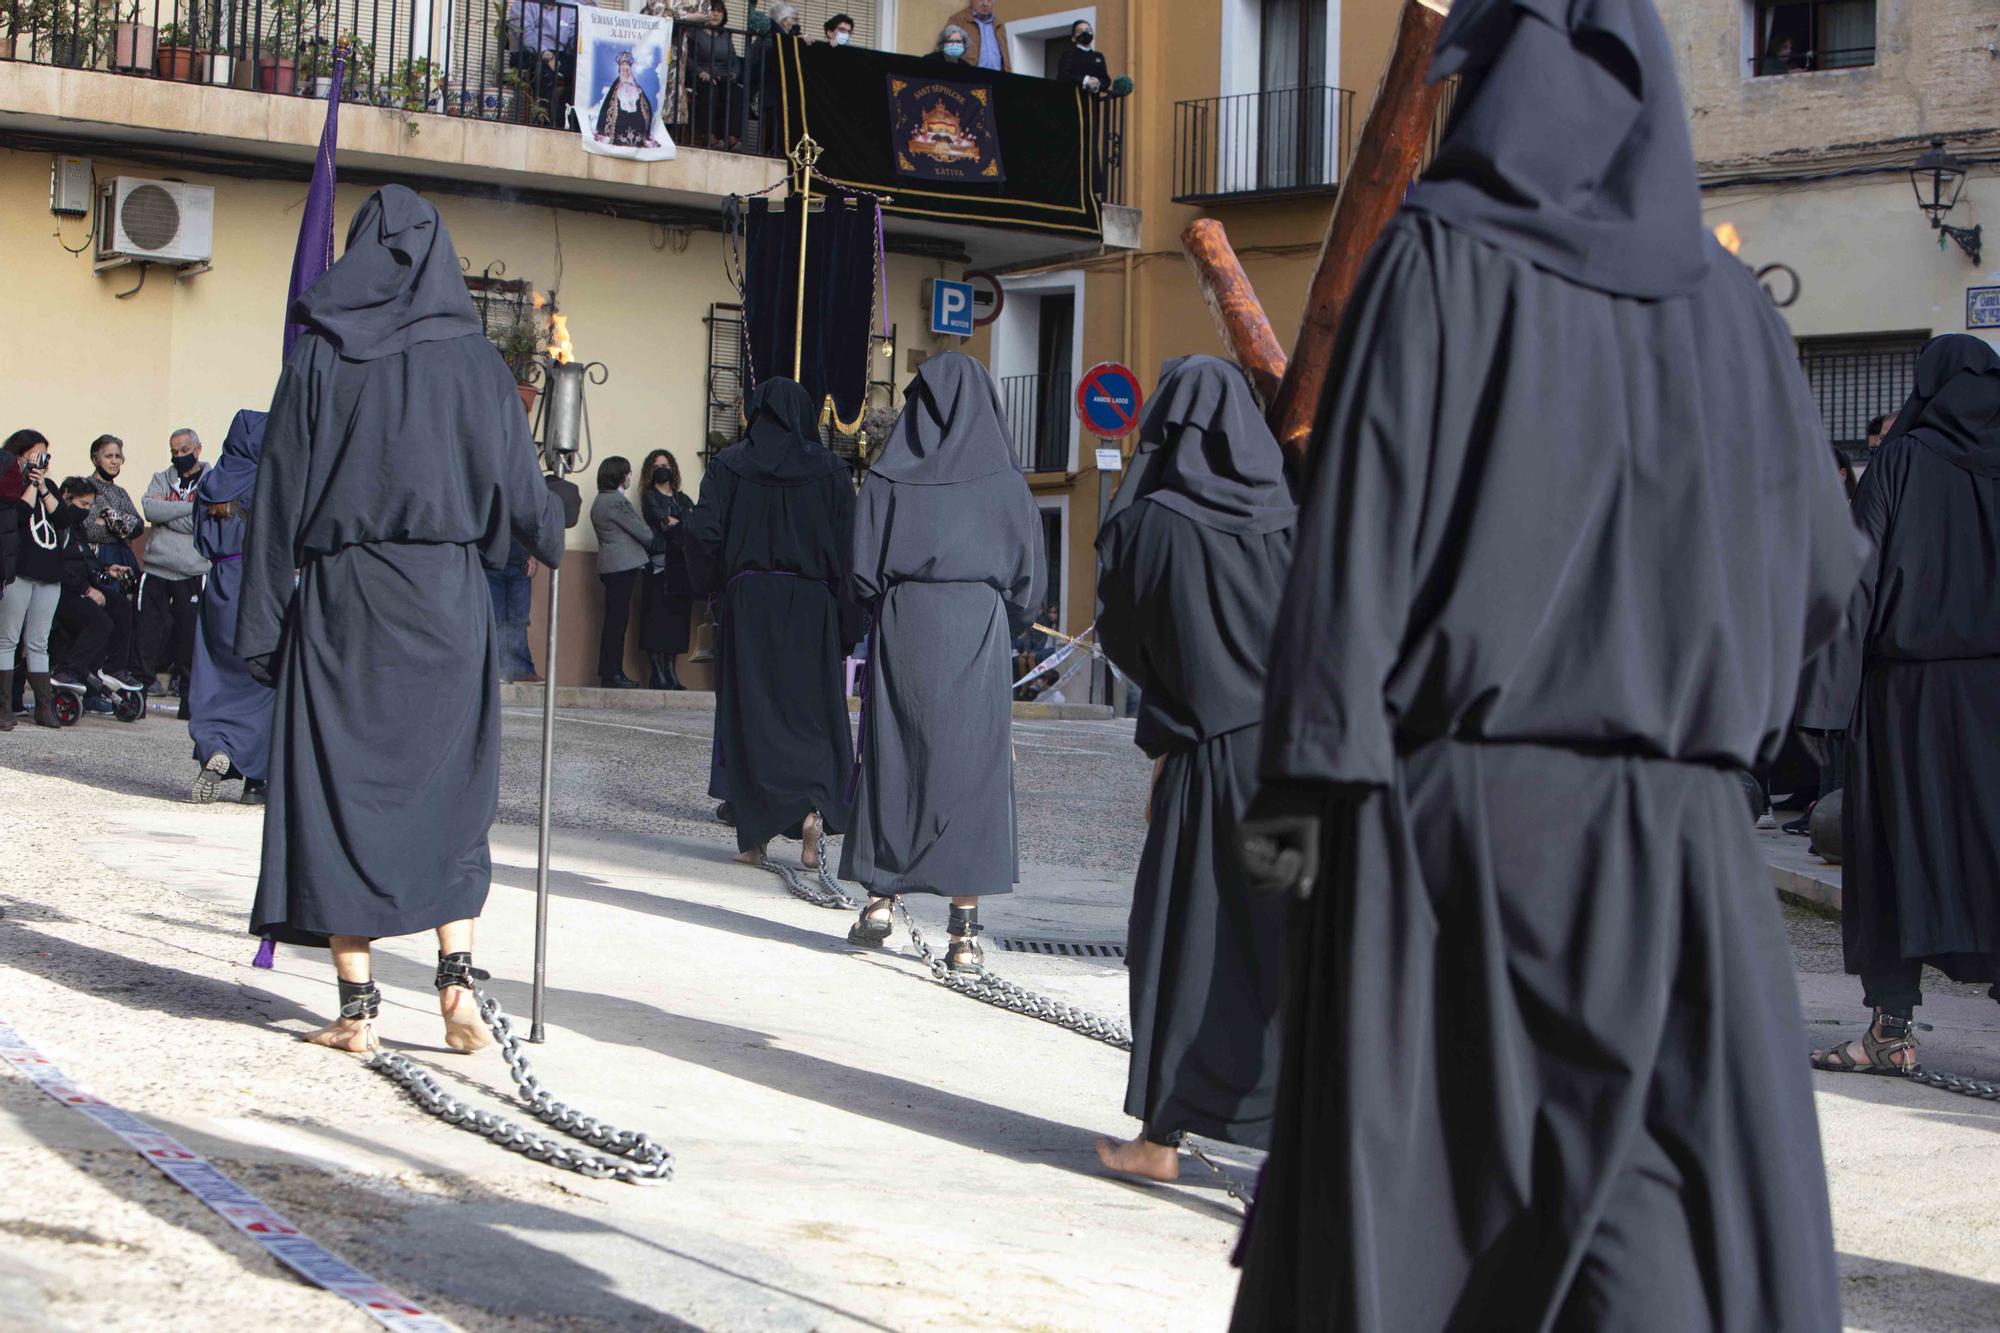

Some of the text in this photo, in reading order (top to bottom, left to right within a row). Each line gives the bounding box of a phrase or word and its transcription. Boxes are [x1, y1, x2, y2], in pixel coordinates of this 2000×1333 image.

[914, 86, 930, 99] SANT
[942, 288, 965, 325] P
[950, 320, 969, 328] MOTOS
[1111, 397, 1129, 405] LADOS
